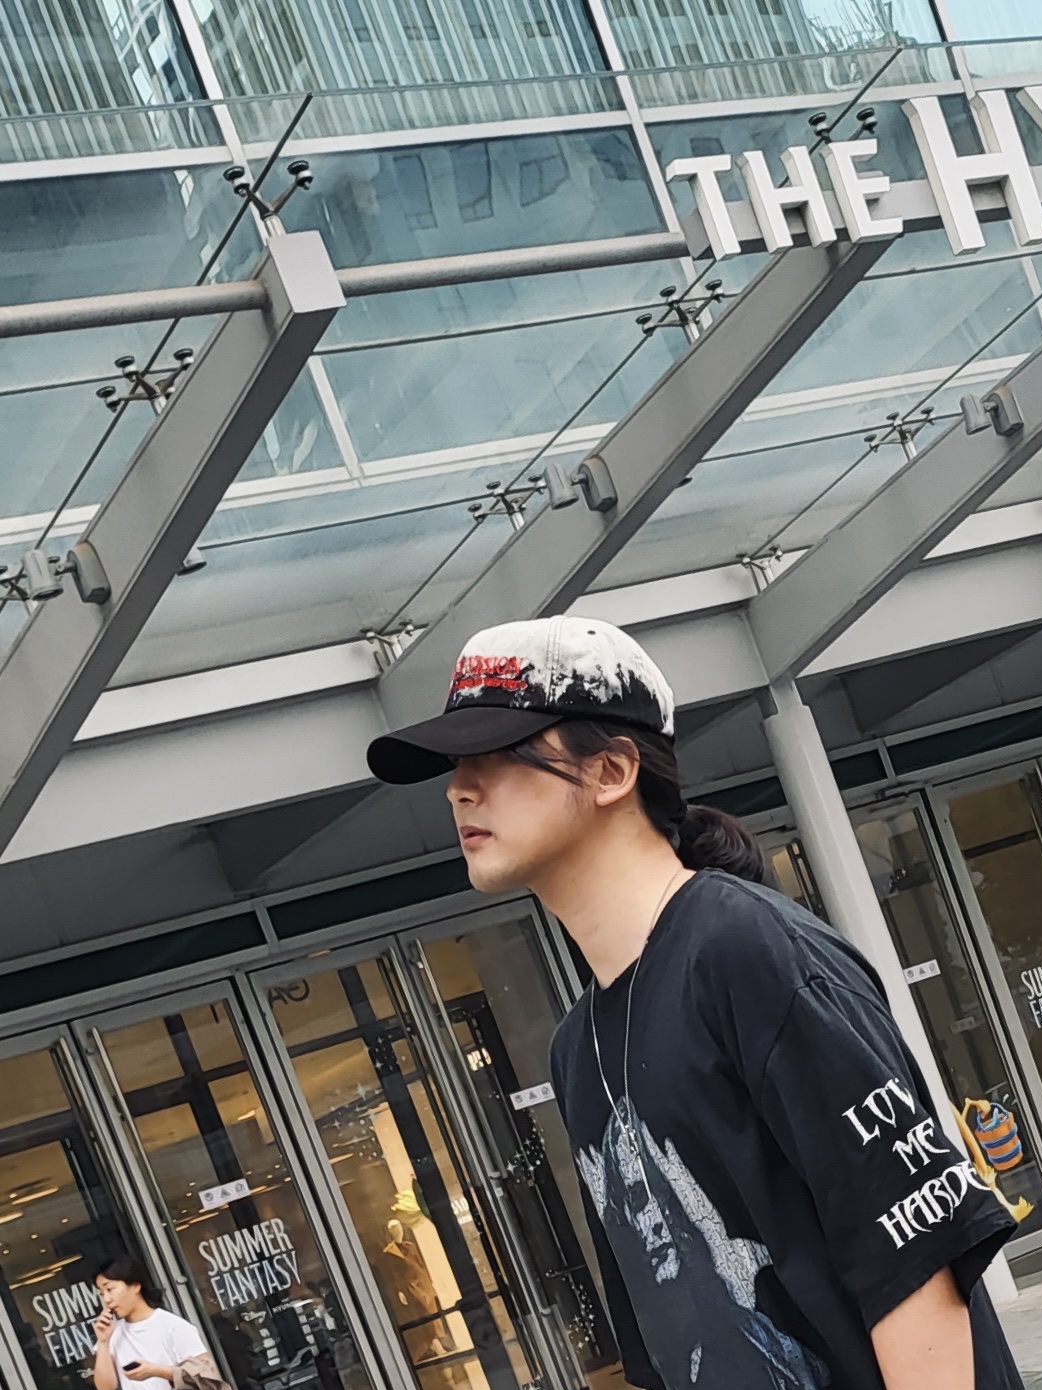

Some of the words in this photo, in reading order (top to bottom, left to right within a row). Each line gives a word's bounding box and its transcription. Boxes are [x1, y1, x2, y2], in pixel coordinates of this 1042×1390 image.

[666, 138, 903, 261] THE
[892, 1117, 951, 1176] ME
[198, 1217, 294, 1277] SUMMER
[210, 1250, 301, 1311] FANTASY
